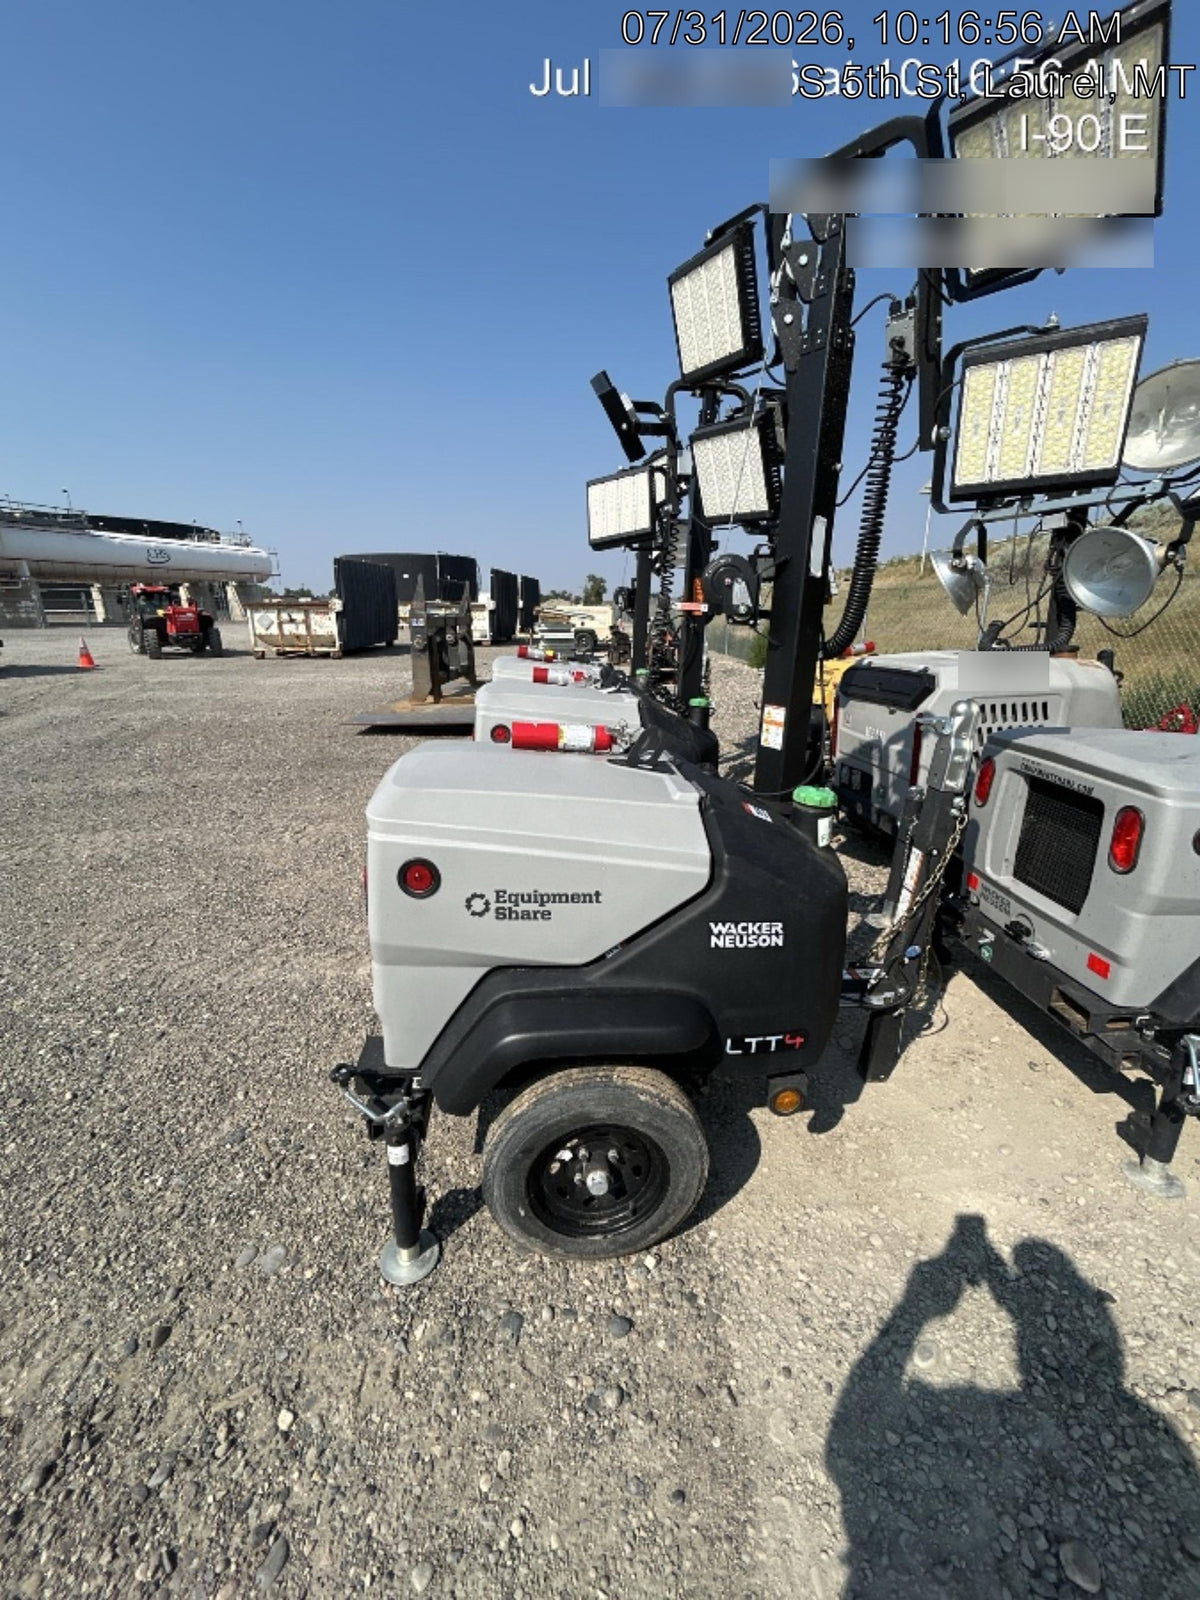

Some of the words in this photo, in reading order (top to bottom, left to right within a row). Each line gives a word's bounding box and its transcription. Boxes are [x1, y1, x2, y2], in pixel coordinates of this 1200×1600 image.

[494, 889, 603, 905] Equipment
[494, 906, 552, 921] Share
[709, 921, 784, 935] WACKER
[710, 934, 784, 949] NEUSON
[725, 1033, 806, 1056] LTT4
